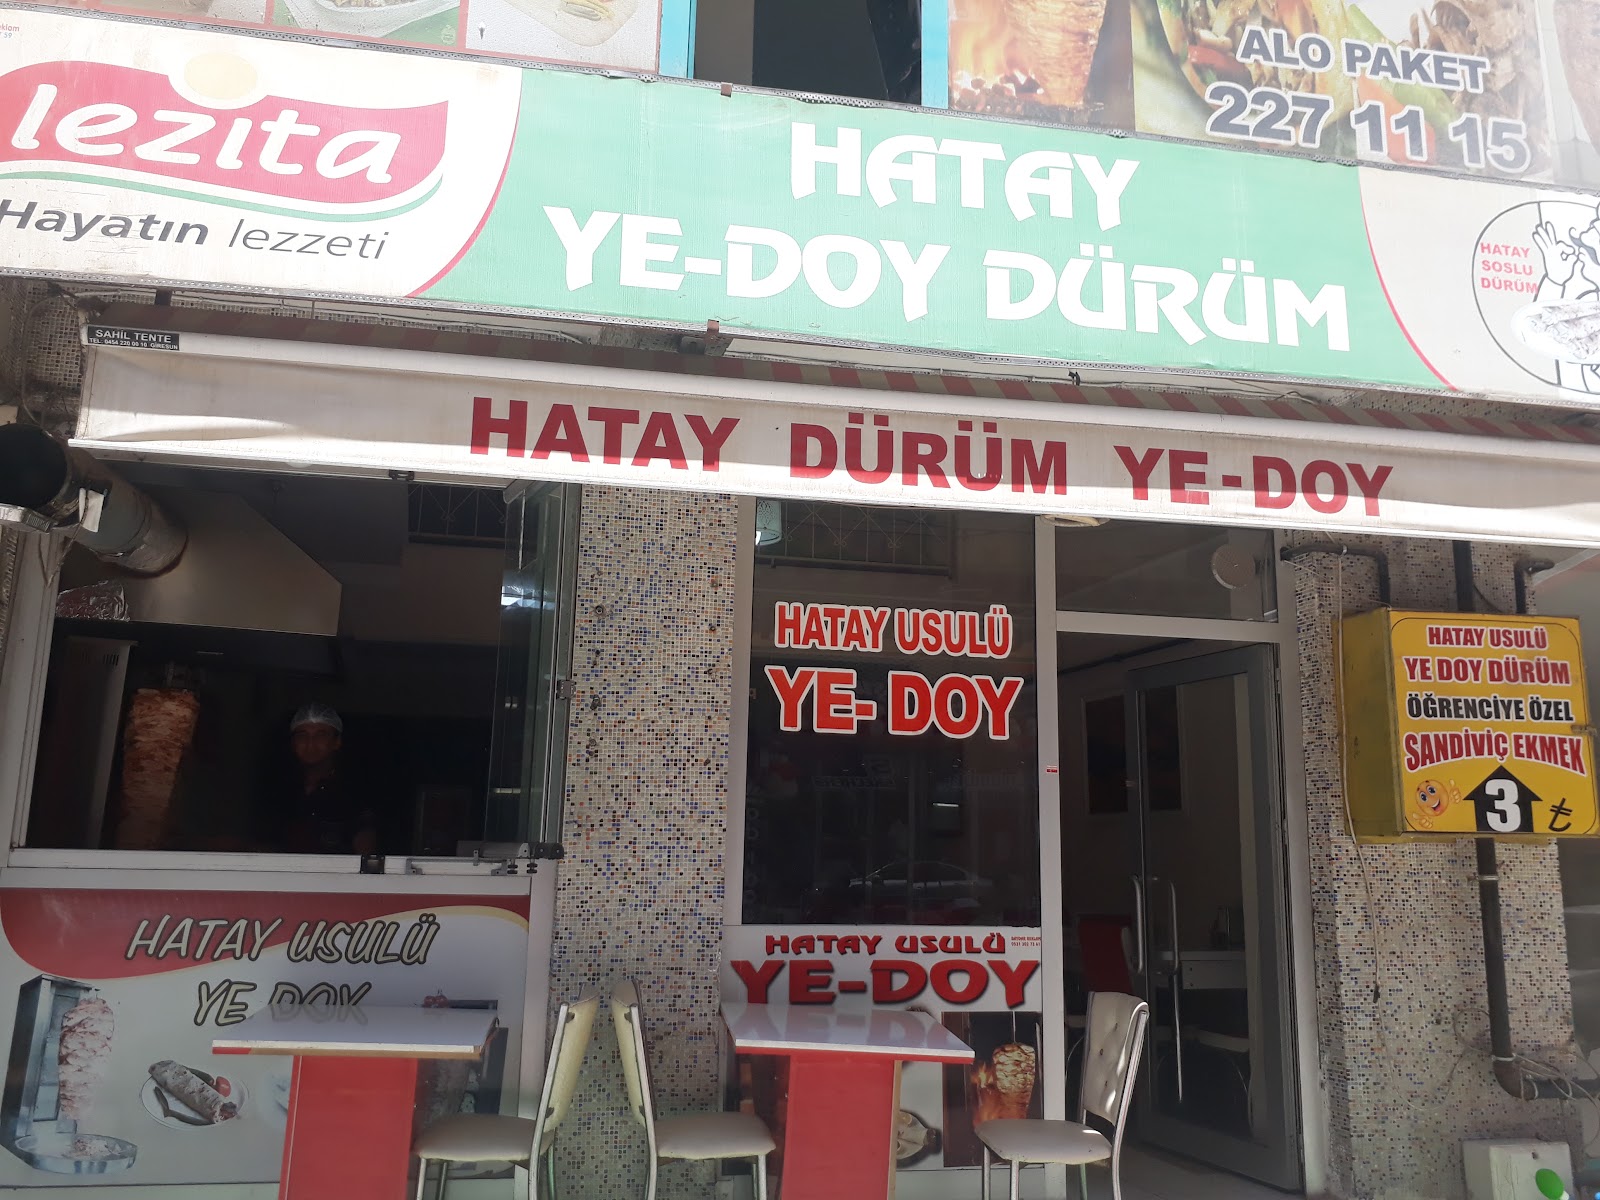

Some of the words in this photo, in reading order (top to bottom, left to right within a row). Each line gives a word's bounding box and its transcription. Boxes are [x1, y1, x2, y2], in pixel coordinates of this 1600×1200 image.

[1238, 28, 1332, 70] ALO
[1342, 40, 1488, 91] PAKET
[1206, 83, 1333, 147] 227
[1350, 101, 1428, 161] 11
[1449, 114, 1531, 172] 15
[790, 122, 1140, 231] HATAY
[0, 199, 208, 245] Hayatın
[228, 219, 389, 260] lezzeti
[1480, 242, 1531, 258] HATAY
[542, 205, 951, 322] YE-DOY
[983, 243, 1350, 353] DÜRÜM
[1481, 260, 1533, 276] SOSLU
[1481, 276, 1539, 294] DÜRÜM
[95, 329, 131, 340] SAHİL
[134, 332, 172, 343] TENTE
[150, 342, 178, 350] GİRESUN
[470, 396, 741, 472] HATAY
[789, 412, 1068, 496] DÜRÜM
[775, 602, 891, 652] HATAY
[894, 604, 1012, 659] USULÜ
[1427, 626, 1486, 647] HATAY
[1488, 626, 1549, 650] USULÜ
[1403, 657, 1433, 681] YE
[1436, 657, 1483, 683] DOY
[1487, 656, 1571, 685] DÜRÜM
[1406, 692, 1526, 721] ÖĞRENCİYE
[1528, 695, 1575, 722] ÖZEL
[1404, 729, 1509, 771] SANDİVİÇ
[1513, 734, 1587, 775] EKMEK
[1485, 778, 1522, 833] 3
[125, 914, 283, 962] HATAY
[286, 912, 440, 966] USULÜ
[765, 935, 883, 956] HATAY
[895, 932, 1005, 955] USULÜ
[194, 978, 257, 1026] YE
[730, 959, 1040, 1009] YE-DOY
